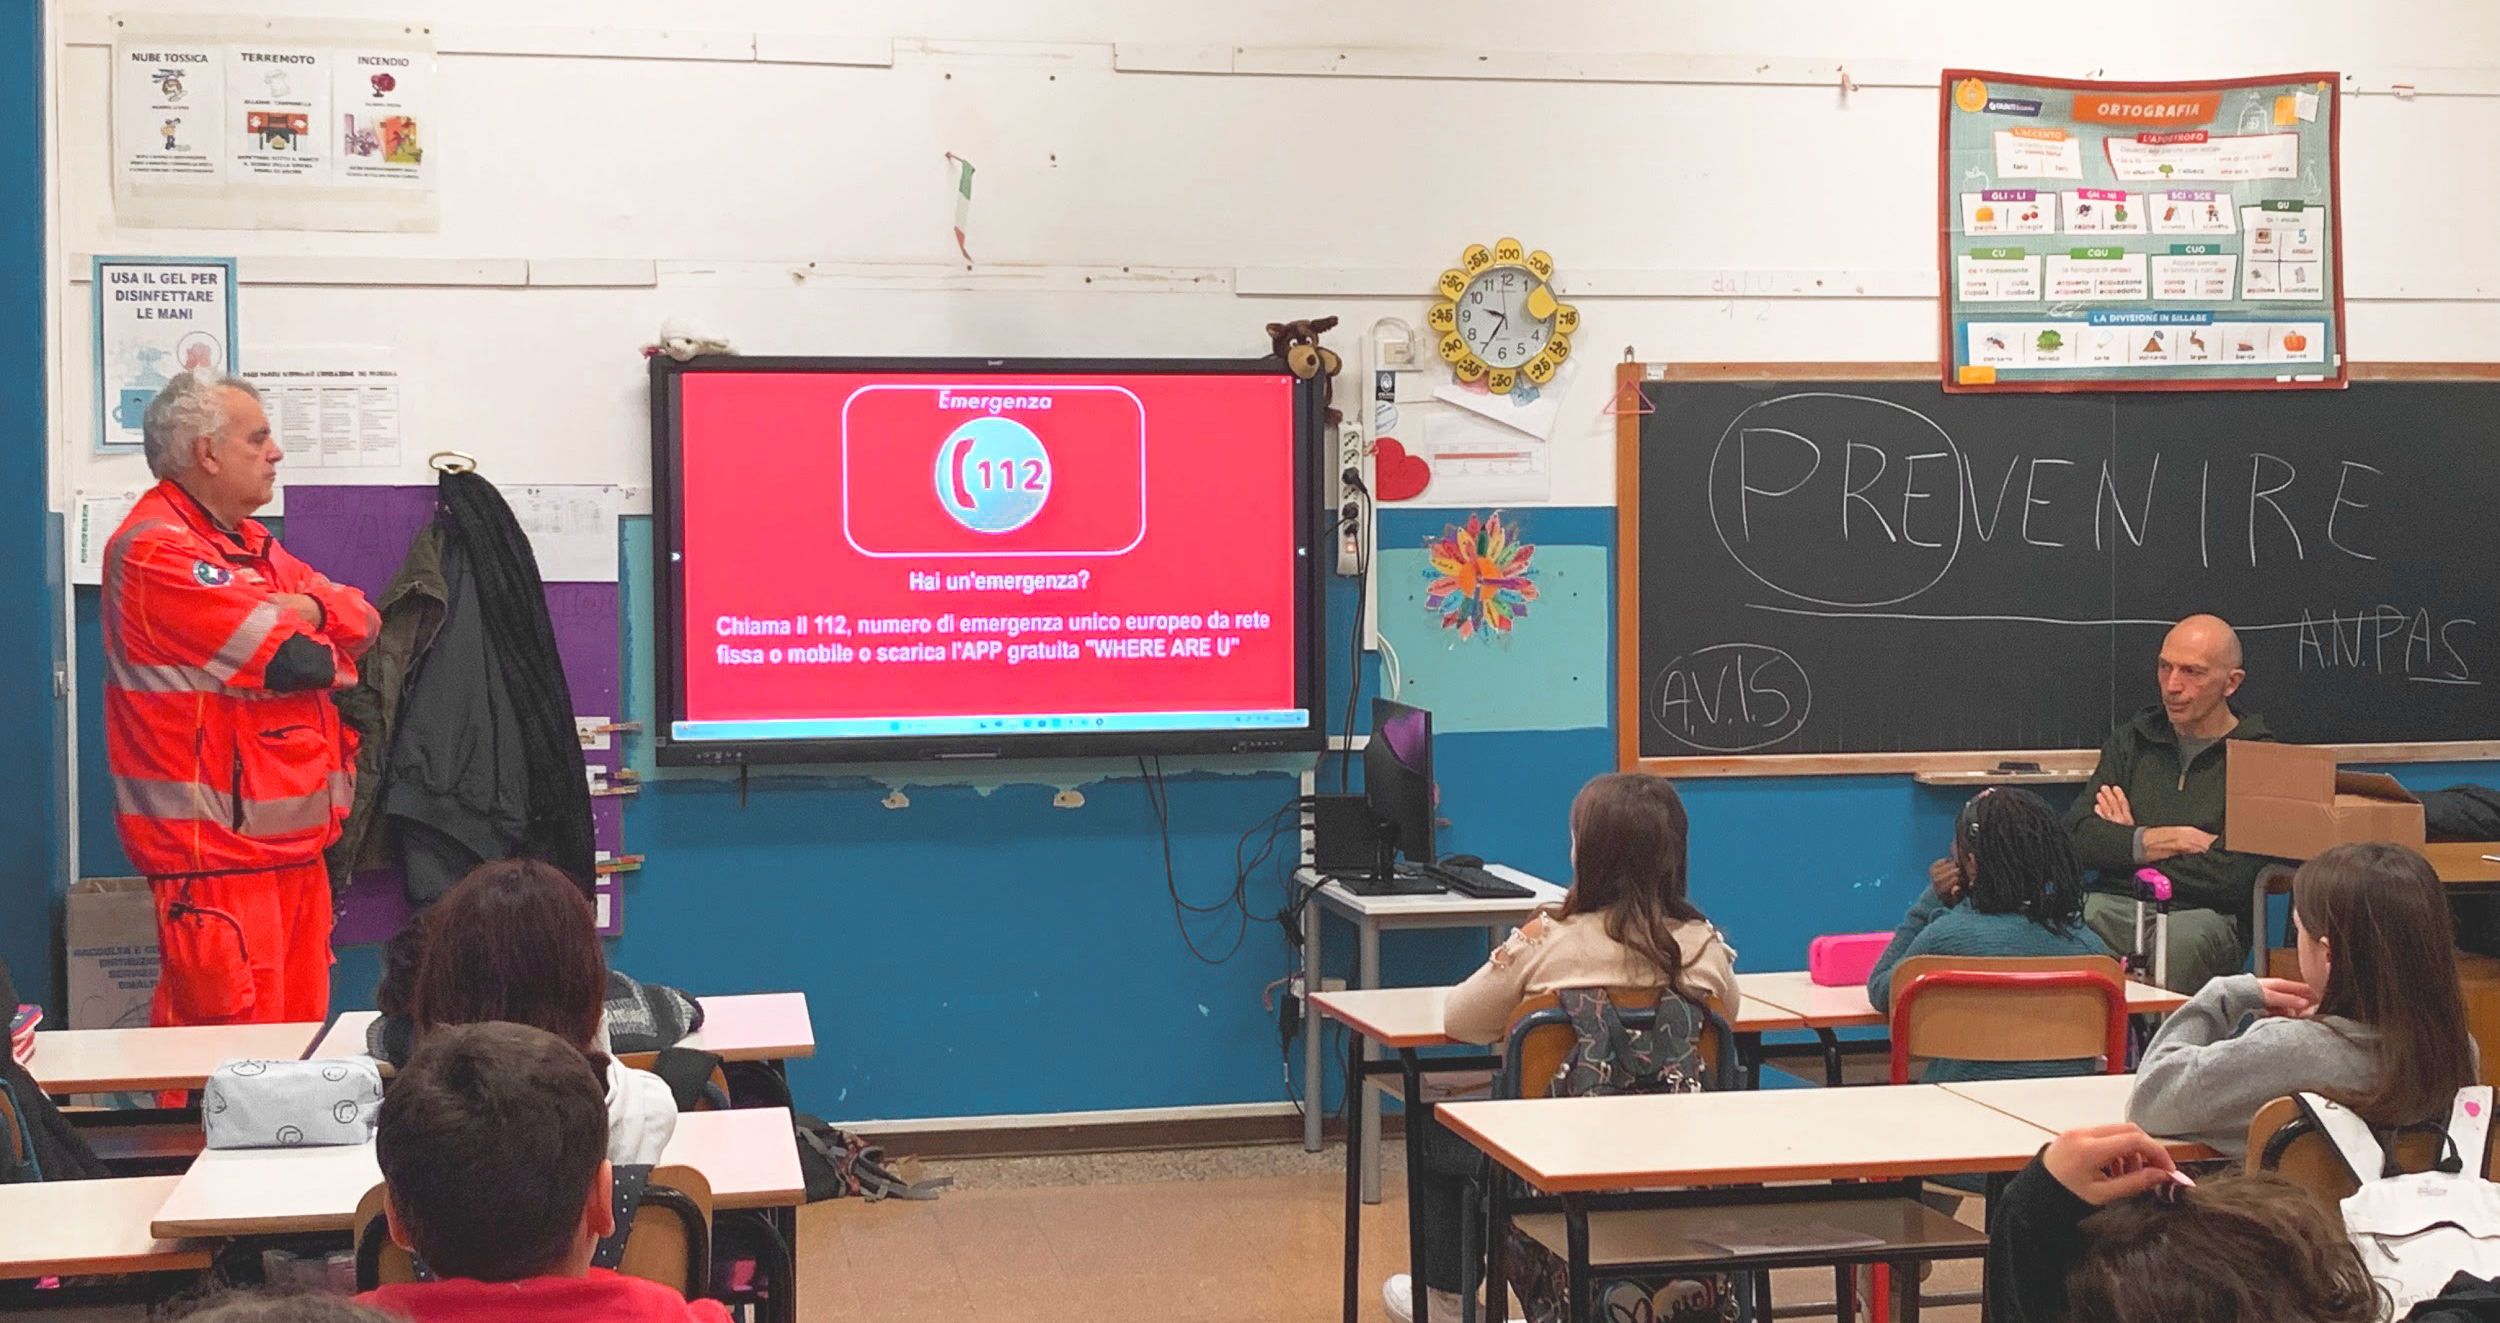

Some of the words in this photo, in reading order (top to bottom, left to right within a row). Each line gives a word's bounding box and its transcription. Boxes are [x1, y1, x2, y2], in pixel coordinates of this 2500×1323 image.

[132, 53, 161, 62] NUBE
[164, 53, 208, 63] TOSSICA
[240, 53, 315, 65] TERREMOTO
[357, 56, 410, 67] INCENDIO
[2097, 102, 2201, 118] ORTOGRAFIA
[2014, 128, 2062, 140] L'ACCENTO
[1991, 192, 2008, 200] GLI
[2016, 192, 2026, 200] LI
[2172, 191, 2189, 200] SCI
[2193, 191, 2212, 200] SCE
[2298, 229, 2307, 244] 5
[1498, 248, 1520, 260] :00
[1992, 249, 2006, 258] CU
[2087, 249, 2109, 257] CQU
[2185, 245, 2206, 254] CUO
[1529, 256, 1551, 276] :05
[111, 272, 139, 284] USA
[143, 272, 156, 284] IL
[160, 273, 187, 285] GEL
[191, 273, 218, 285] PER
[1442, 274, 1465, 293] :50
[1483, 278, 1494, 292] 11
[1501, 273, 1514, 287] 12
[1523, 278, 1528, 292] 1
[115, 290, 214, 302] DISINFETTARE
[1470, 291, 1484, 305] 10
[136, 308, 154, 320] LE
[157, 308, 193, 320] MANI
[1431, 308, 1453, 323] :45
[1462, 309, 1471, 323] 9
[2160, 314, 2169, 322] IN
[2171, 314, 2207, 322] SILLABE
[1467, 327, 1477, 341] 8
[1531, 328, 1540, 342] 4
[1480, 341, 1489, 354] 7
[1497, 346, 1507, 360] 6
[1516, 342, 1526, 356] 5
[938, 389, 1053, 414] Emergenza
[976, 459, 1047, 491] 112
[1741, 428, 2385, 569] PREVENIRE
[909, 571, 941, 591] Hai
[946, 569, 1091, 595] un'emergenza?
[716, 615, 791, 636] Chiama
[796, 615, 808, 635] il
[814, 615, 853, 637] 112,
[857, 617, 932, 634] numero
[937, 614, 954, 633] di
[959, 616, 1064, 637] emergenza
[1069, 611, 1121, 632] unico
[1125, 614, 1202, 635] europeo
[1207, 610, 1230, 630] da
[1235, 610, 1271, 629] rete
[716, 643, 764, 664] fissa
[769, 648, 782, 664] o
[787, 643, 853, 663] mobile
[859, 647, 872, 662] o
[876, 642, 946, 661] scarica
[951, 640, 1003, 660] l'APP
[1007, 639, 1080, 665] gratuita
[1085, 638, 1167, 658] "WHERE
[1170, 637, 1211, 657] ARE
[1217, 636, 1240, 657] U"
